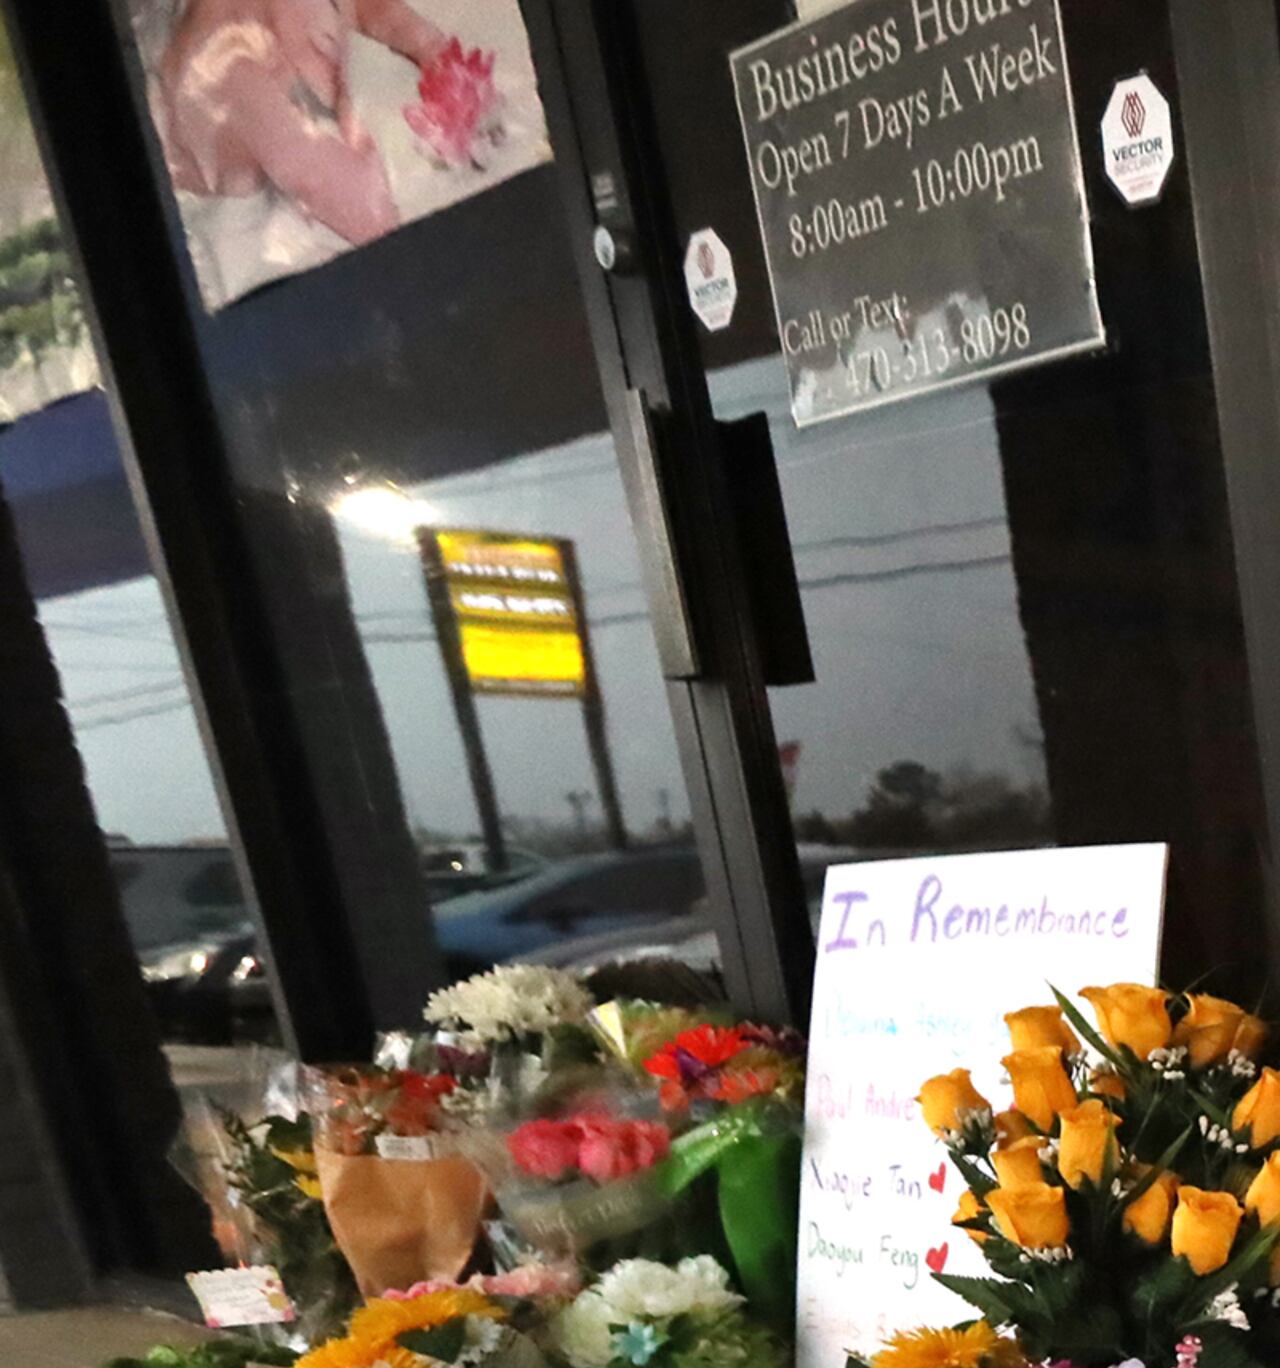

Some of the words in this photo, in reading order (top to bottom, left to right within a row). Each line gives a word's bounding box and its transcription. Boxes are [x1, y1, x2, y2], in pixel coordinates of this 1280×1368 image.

[749, 16, 900, 122] Business
[756, 132, 832, 197] Open
[834, 110, 851, 158] 7
[858, 88, 931, 149] Days
[938, 66, 963, 118] A
[964, 23, 1057, 102] Week
[1112, 136, 1164, 161] VECTOR
[789, 194, 888, 259] 8:00am
[911, 134, 1043, 213] 10:00pm
[783, 309, 826, 356] Call
[829, 311, 851, 342] or
[853, 291, 910, 331] Text:
[824, 891, 887, 954] In
[889, 1164, 922, 1200] Tan
[879, 1234, 919, 1291] Feng
